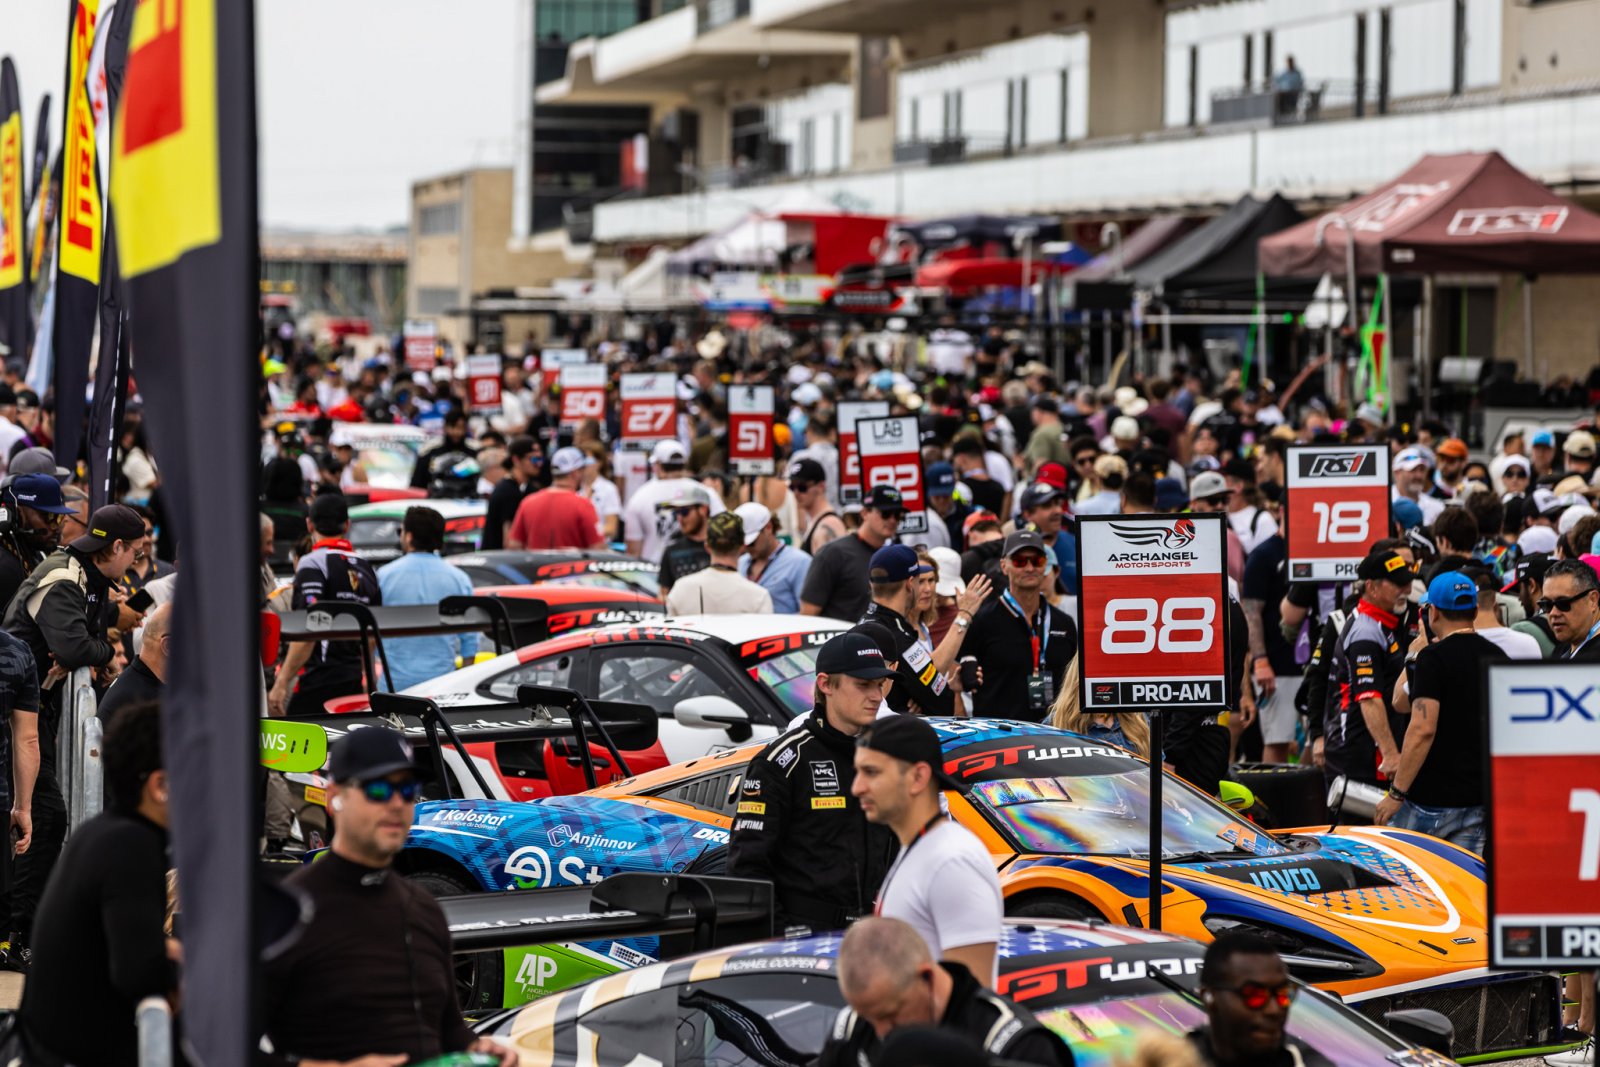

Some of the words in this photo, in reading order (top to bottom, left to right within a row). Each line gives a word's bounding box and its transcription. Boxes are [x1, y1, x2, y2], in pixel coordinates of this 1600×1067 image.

[563, 390, 605, 417] 50
[628, 403, 675, 432] 27
[737, 421, 767, 451] 51
[872, 420, 902, 439] LAB
[1313, 501, 1371, 543] 18
[1107, 552, 1198, 562] ARCHANGEL
[1100, 597, 1216, 655] 88
[741, 631, 817, 658] GT
[907, 648, 923, 663] aws
[1132, 683, 1211, 702] PRO-AM
[1509, 686, 1600, 723] DX
[777, 748, 795, 767] OMP
[942, 744, 1036, 778] GT
[743, 779, 761, 790] aws
[443, 809, 508, 827] Kolostat
[568, 831, 637, 851] Anjinnov
[722, 958, 767, 971] MICHAEL
[769, 957, 818, 969] COOPER
[995, 956, 1113, 1003] GT
